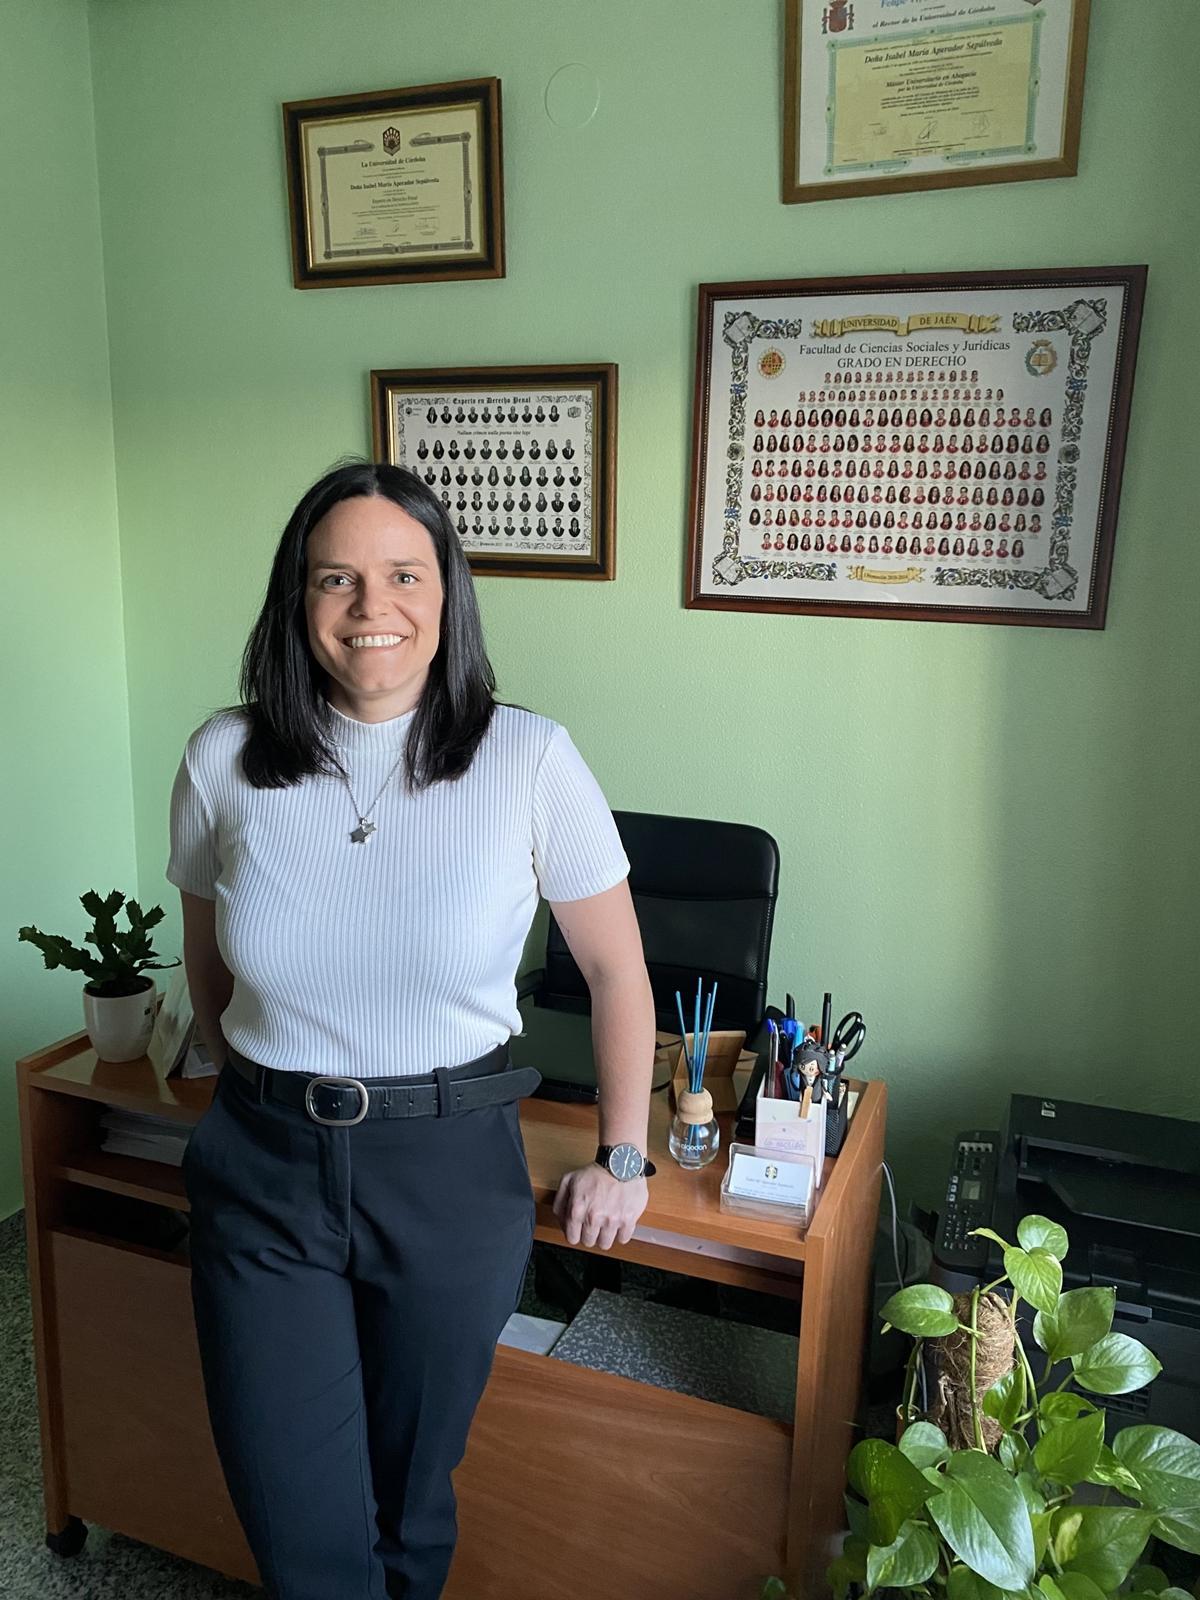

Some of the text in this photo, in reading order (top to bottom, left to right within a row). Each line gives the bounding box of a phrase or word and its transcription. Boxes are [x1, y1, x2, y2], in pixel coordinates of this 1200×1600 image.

[920, 11, 956, 21] Universidad
[864, 54, 882, 64] Doña
[885, 51, 906, 60] Isabel
[932, 44, 964, 55] Aperador
[966, 38, 1003, 50] Sepúlveda
[369, 159, 397, 167] Universidad
[844, 318, 898, 329] UNIVERSIDAD
[934, 316, 958, 325] JAÉN
[800, 340, 1010, 355] Facultad de Ciencias Sociales y Jurídicas
[837, 356, 966, 368] GRADO EN DERECHO
